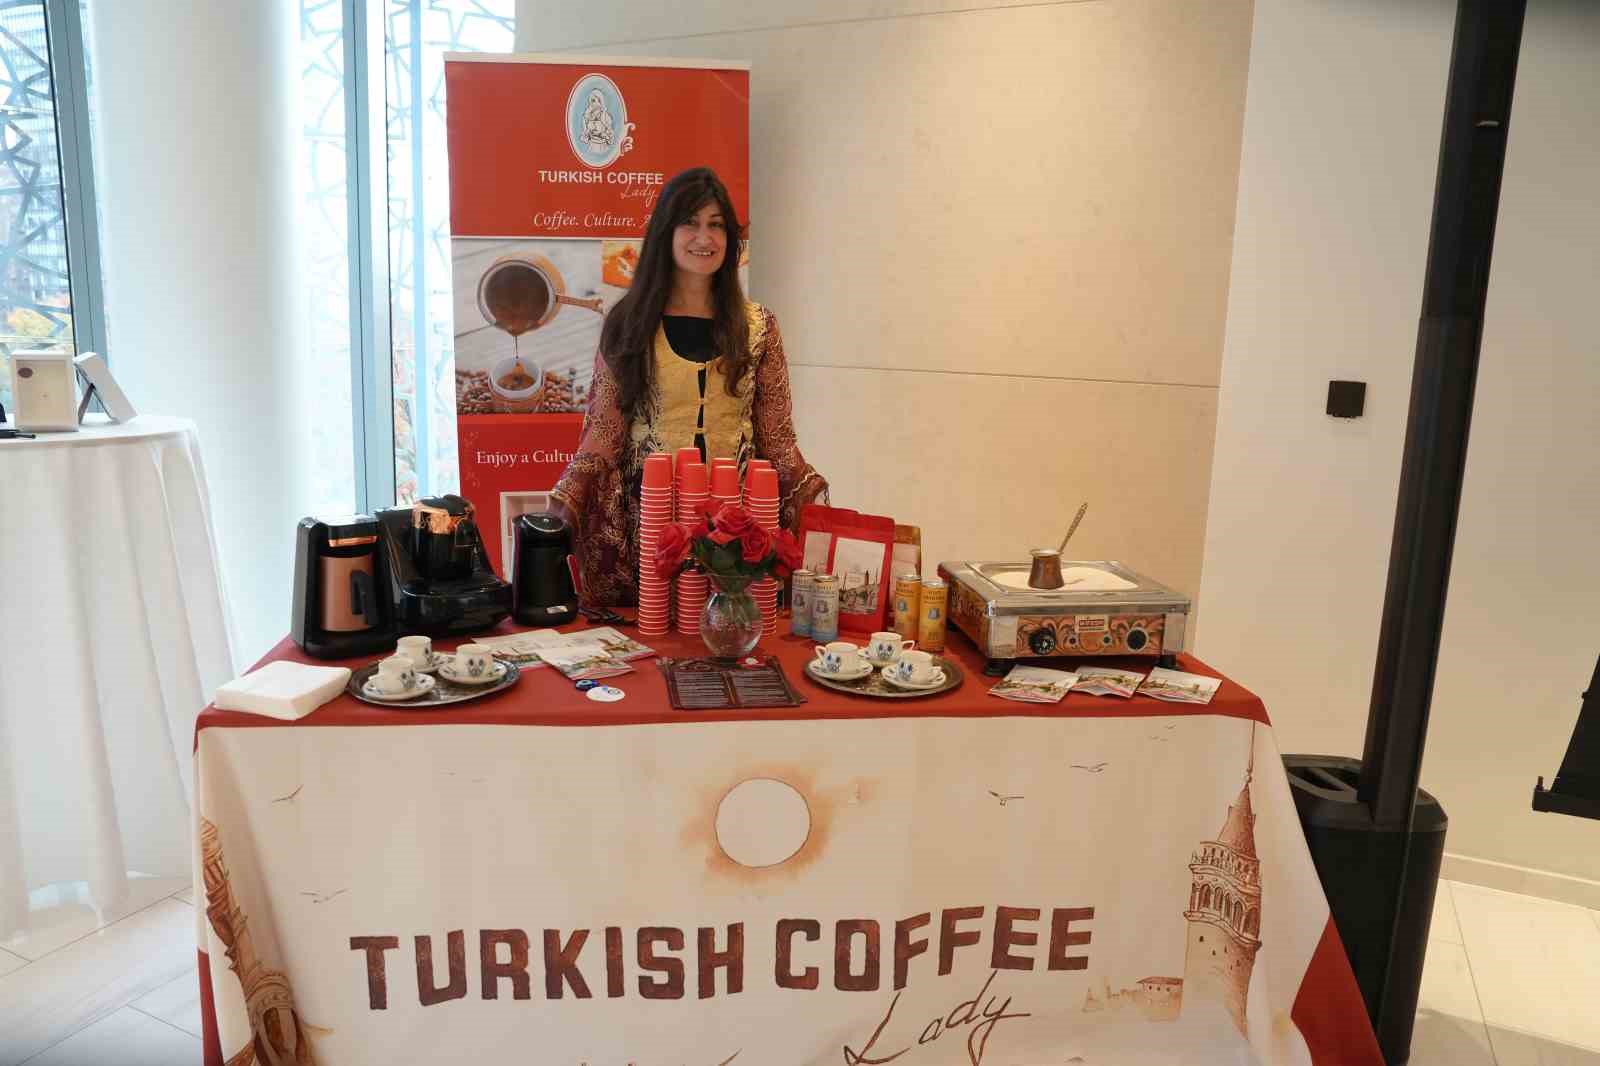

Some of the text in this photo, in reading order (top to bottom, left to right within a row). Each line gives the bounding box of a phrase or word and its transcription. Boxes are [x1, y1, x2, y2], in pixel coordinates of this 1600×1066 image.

[538, 170, 665, 185] TURKISH COFFEE
[533, 210, 580, 230] Coffee.
[584, 211, 637, 228] Culture.
[476, 448, 576, 469] Enjoy a Cultu
[349, 905, 1096, 1011] TURKISH COFFEE
[843, 968, 1032, 1066] Lady
